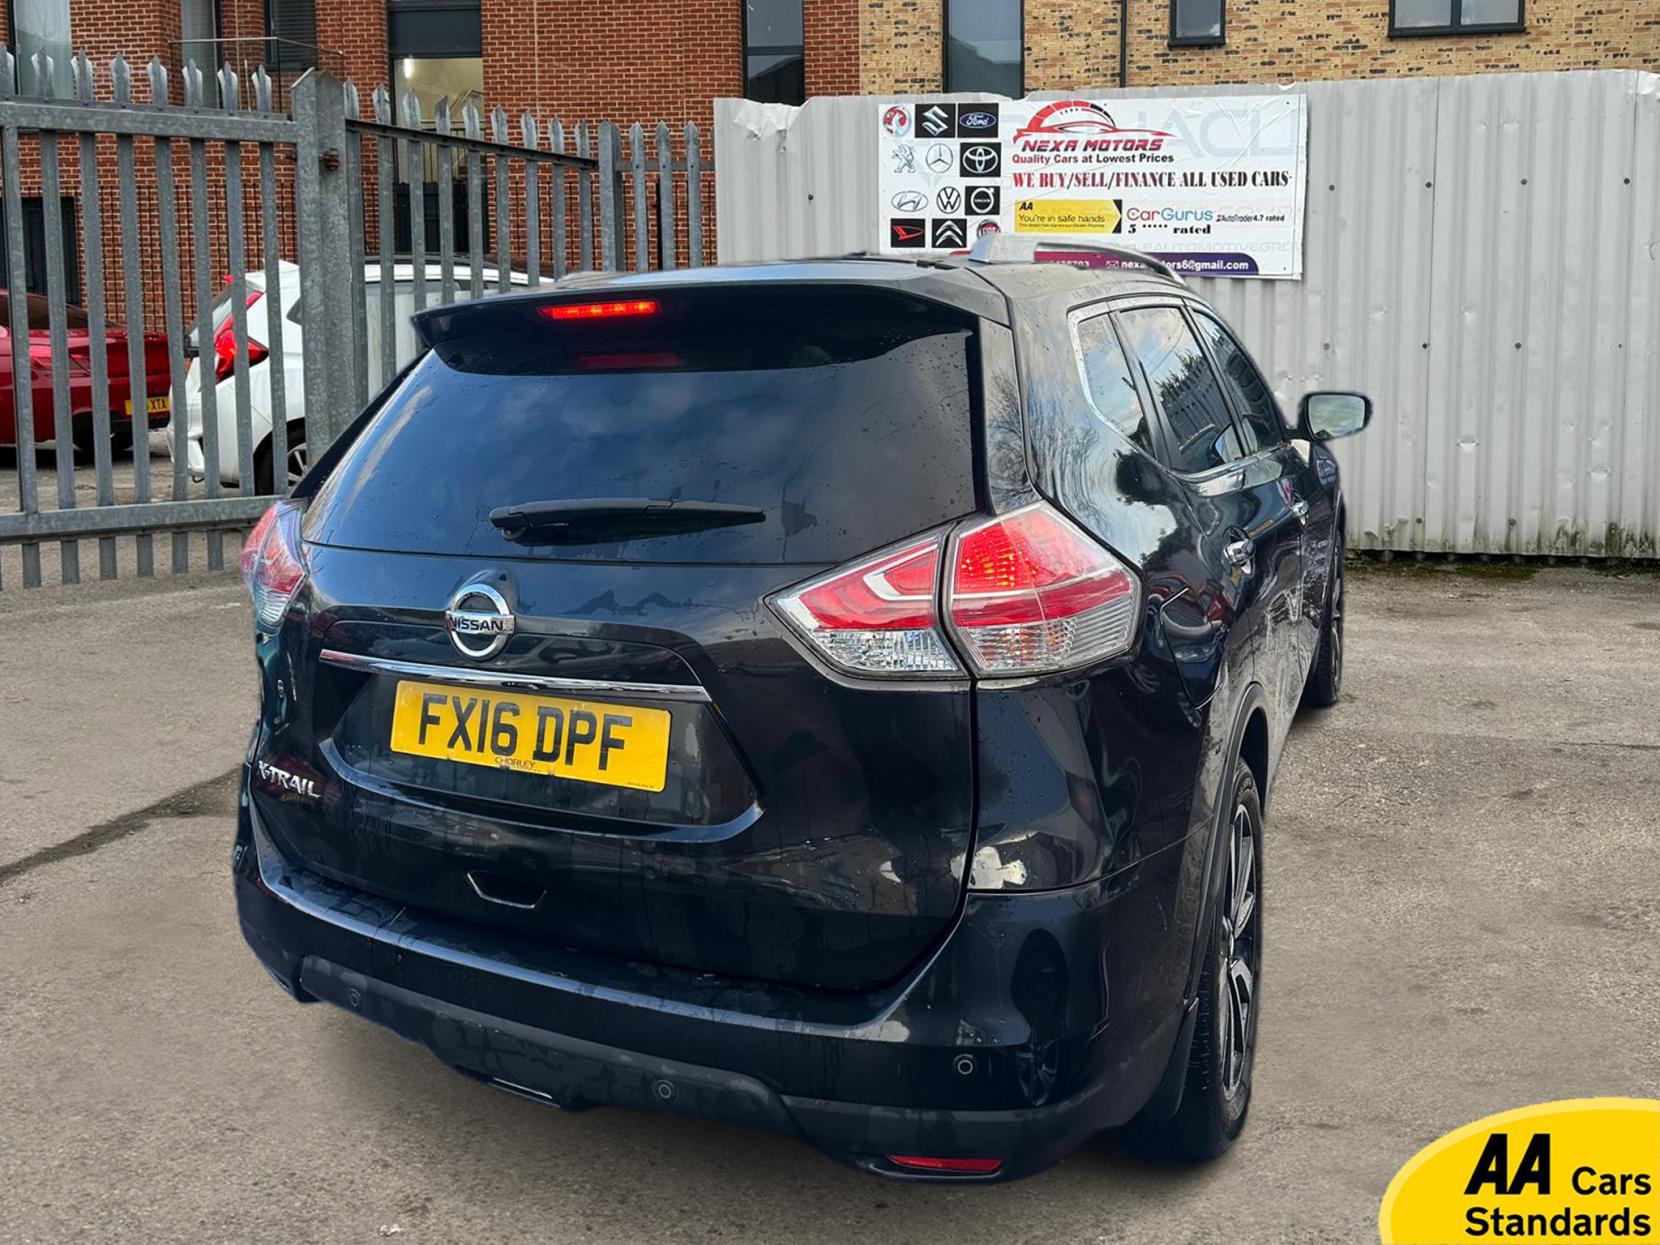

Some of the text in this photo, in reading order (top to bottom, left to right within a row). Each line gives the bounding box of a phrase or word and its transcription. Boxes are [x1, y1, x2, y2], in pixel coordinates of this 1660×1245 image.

[966, 113, 990, 126] Ford
[1021, 138, 1164, 152] NEXA MOTORS
[1012, 152, 1175, 166] Quality Cars at Lowest Prices
[1013, 170, 1289, 190] WE BUY/SELL/FINANCE ALL USED CARS
[1019, 201, 1034, 211] AA
[1018, 214, 1105, 222] You're in safe hands
[1126, 206, 1213, 221] CarGurus
[1265, 214, 1285, 222] rated
[1127, 224, 1211, 234] 5 rated
[448, 615, 503, 631] NISSAN
[418, 692, 633, 771] FX16 DPF
